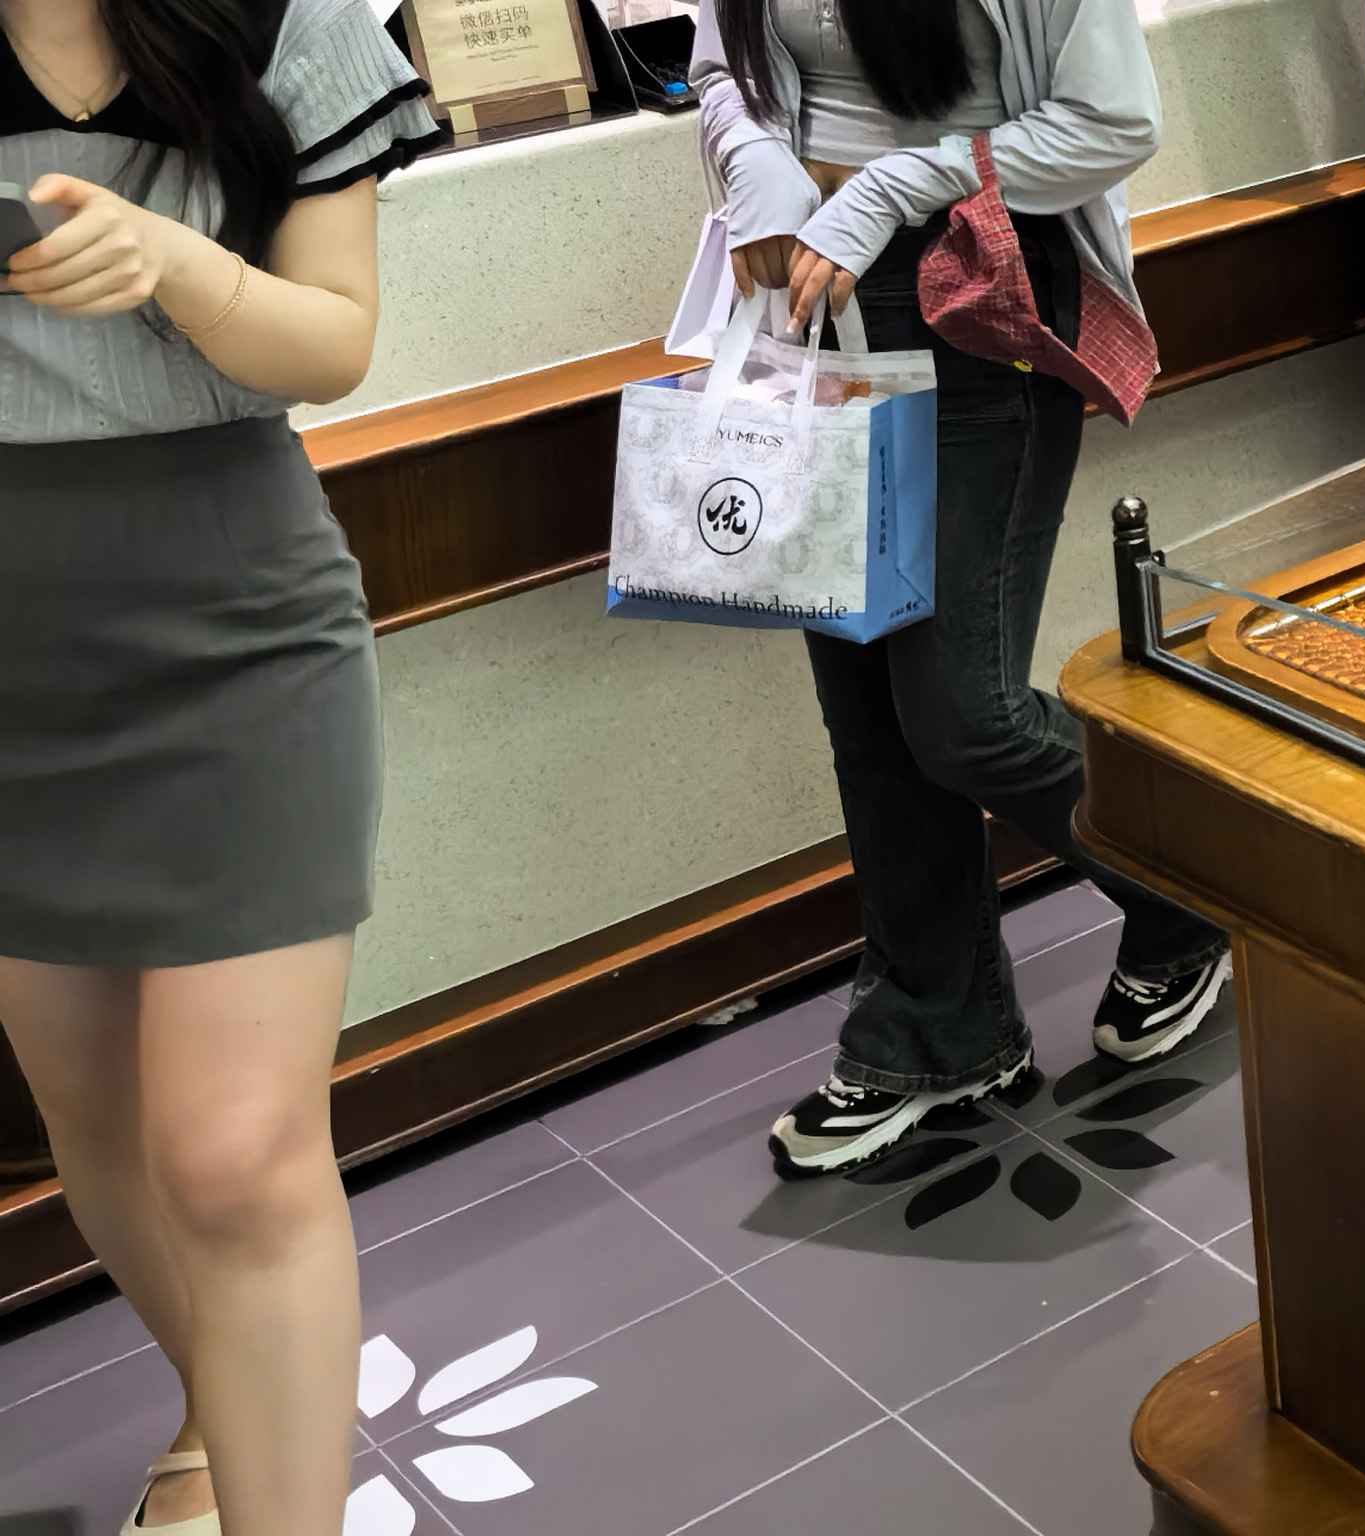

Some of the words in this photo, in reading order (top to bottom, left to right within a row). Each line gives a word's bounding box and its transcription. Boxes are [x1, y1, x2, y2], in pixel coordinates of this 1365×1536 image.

[718, 428, 783, 448] YUMEICS
[614, 575, 716, 611] Champion
[721, 590, 849, 621] Handmade
